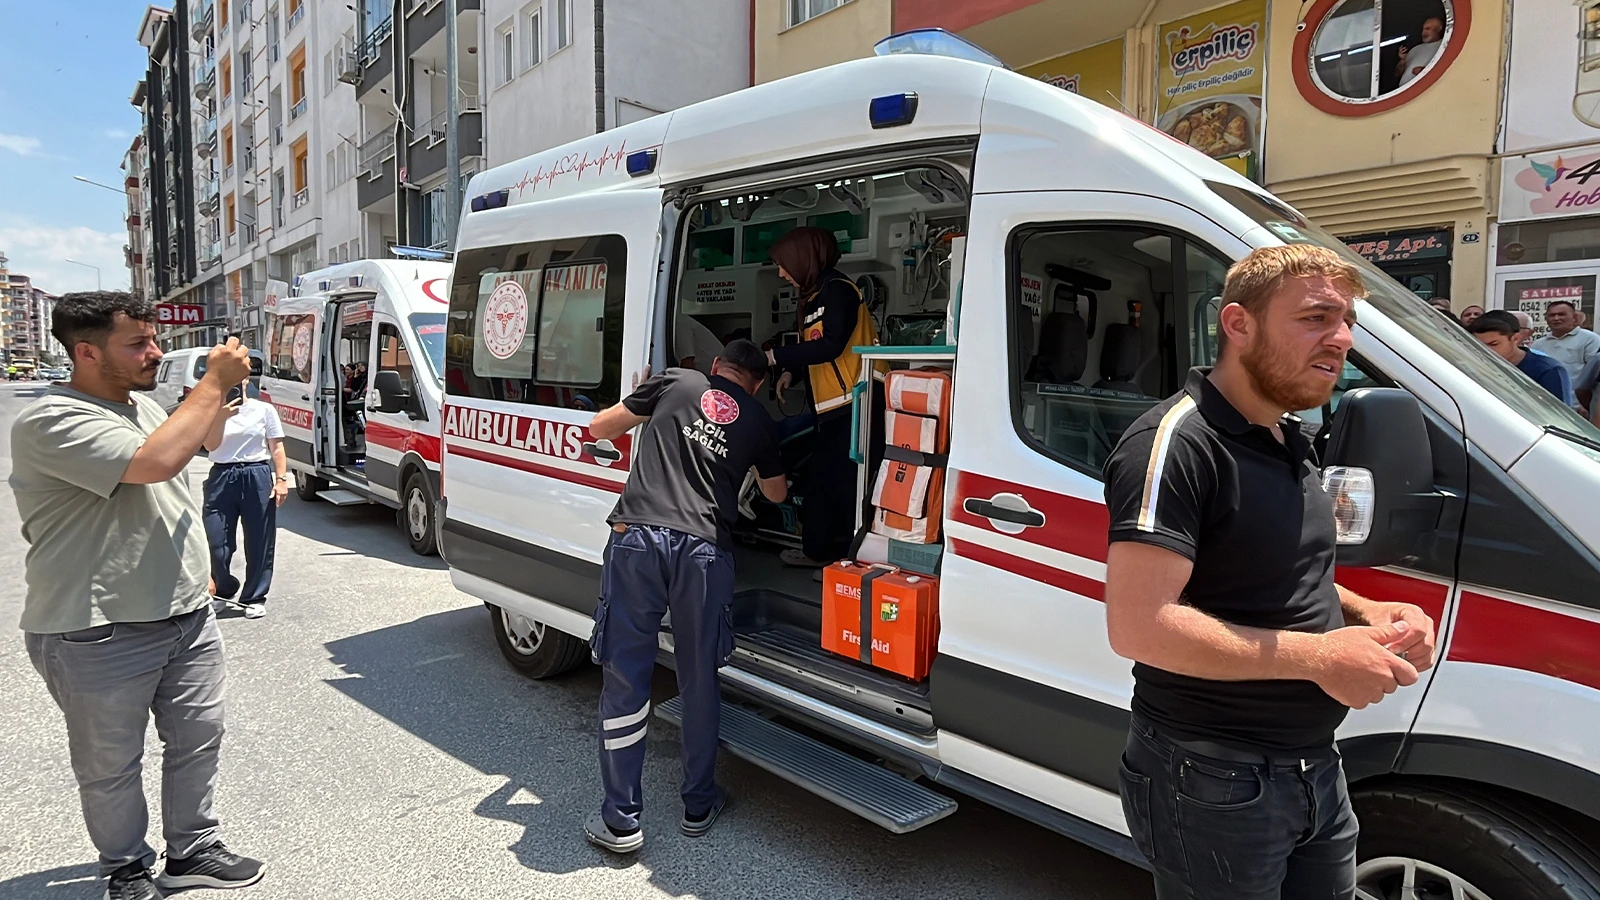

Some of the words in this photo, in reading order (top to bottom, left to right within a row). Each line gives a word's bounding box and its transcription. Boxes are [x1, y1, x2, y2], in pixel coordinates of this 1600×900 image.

[1175, 30, 1251, 66] erpiliç
[1167, 86, 1181, 95] Her
[1182, 82, 1197, 93] piliç
[1198, 76, 1221, 88] Erpiliç
[1222, 68, 1253, 82] değildir
[1347, 240, 1389, 255] NEŞ
[1394, 236, 1442, 253] Apt.
[1522, 287, 1579, 298] SATILIK
[159, 305, 199, 322] BİM
[1521, 301, 1540, 311] 0542
[444, 406, 583, 460] AMBULANS
[682, 425, 729, 458] SAĞLIK
[693, 418, 727, 443] ACİL
[843, 629, 861, 646] Firs
[870, 638, 890, 654] Aid
